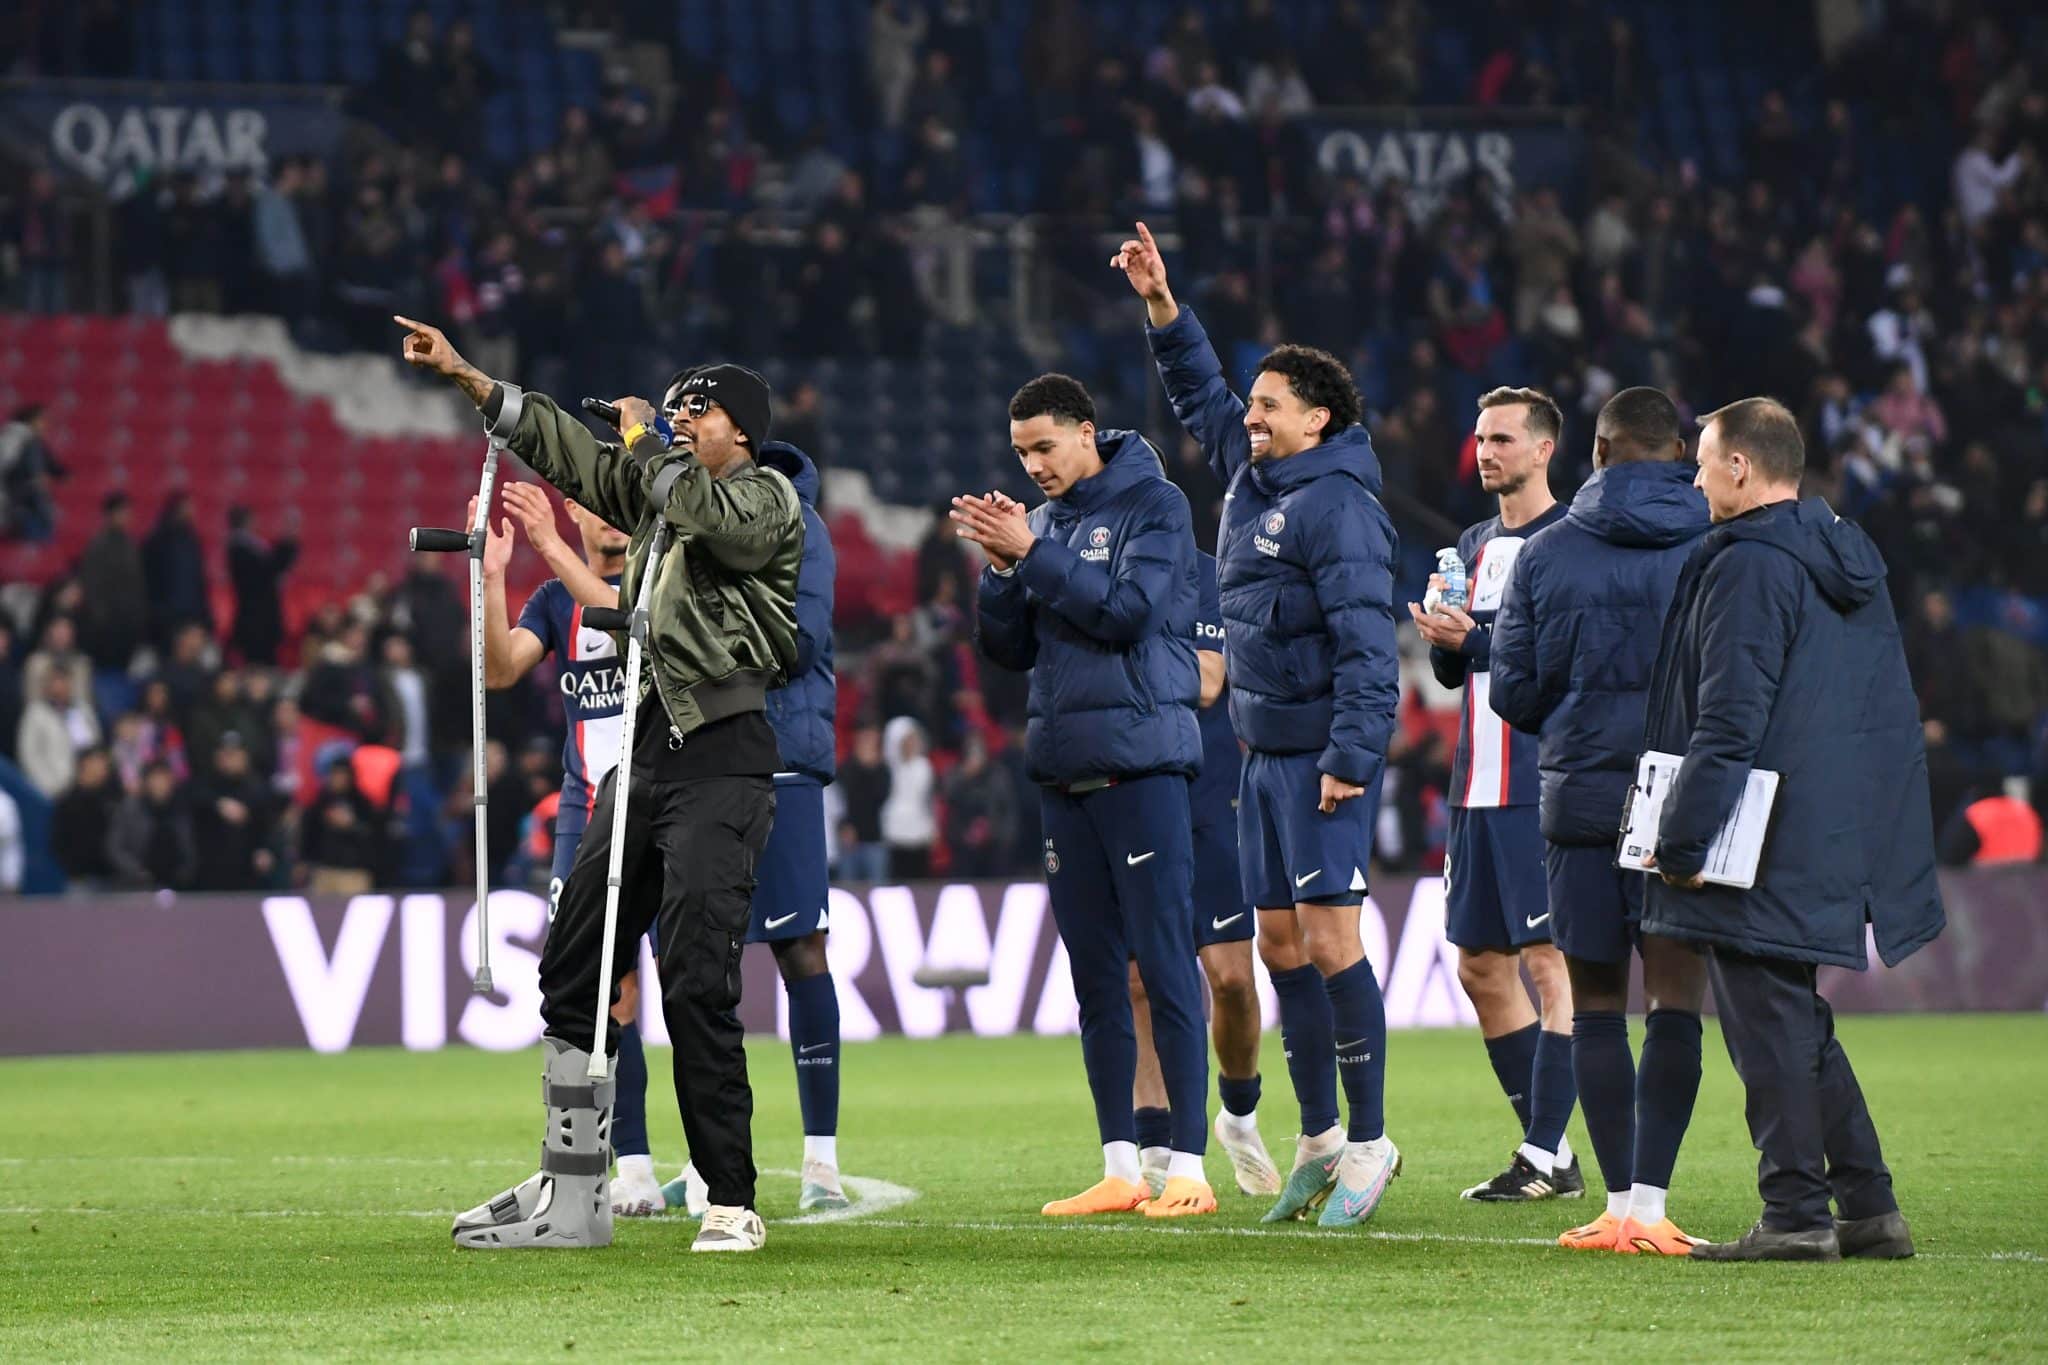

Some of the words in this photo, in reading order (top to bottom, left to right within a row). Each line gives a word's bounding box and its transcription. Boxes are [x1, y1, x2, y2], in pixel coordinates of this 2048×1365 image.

[52, 105, 268, 182] QATAR
[1080, 547, 1110, 559] QATAR
[1254, 535, 1281, 553] QATAR
[560, 667, 626, 698] QATA
[579, 690, 626, 709] AIRW
[262, 890, 672, 1053] VIS
[797, 1057, 833, 1065] PARIS
[1335, 1052, 1371, 1063] PARIS
